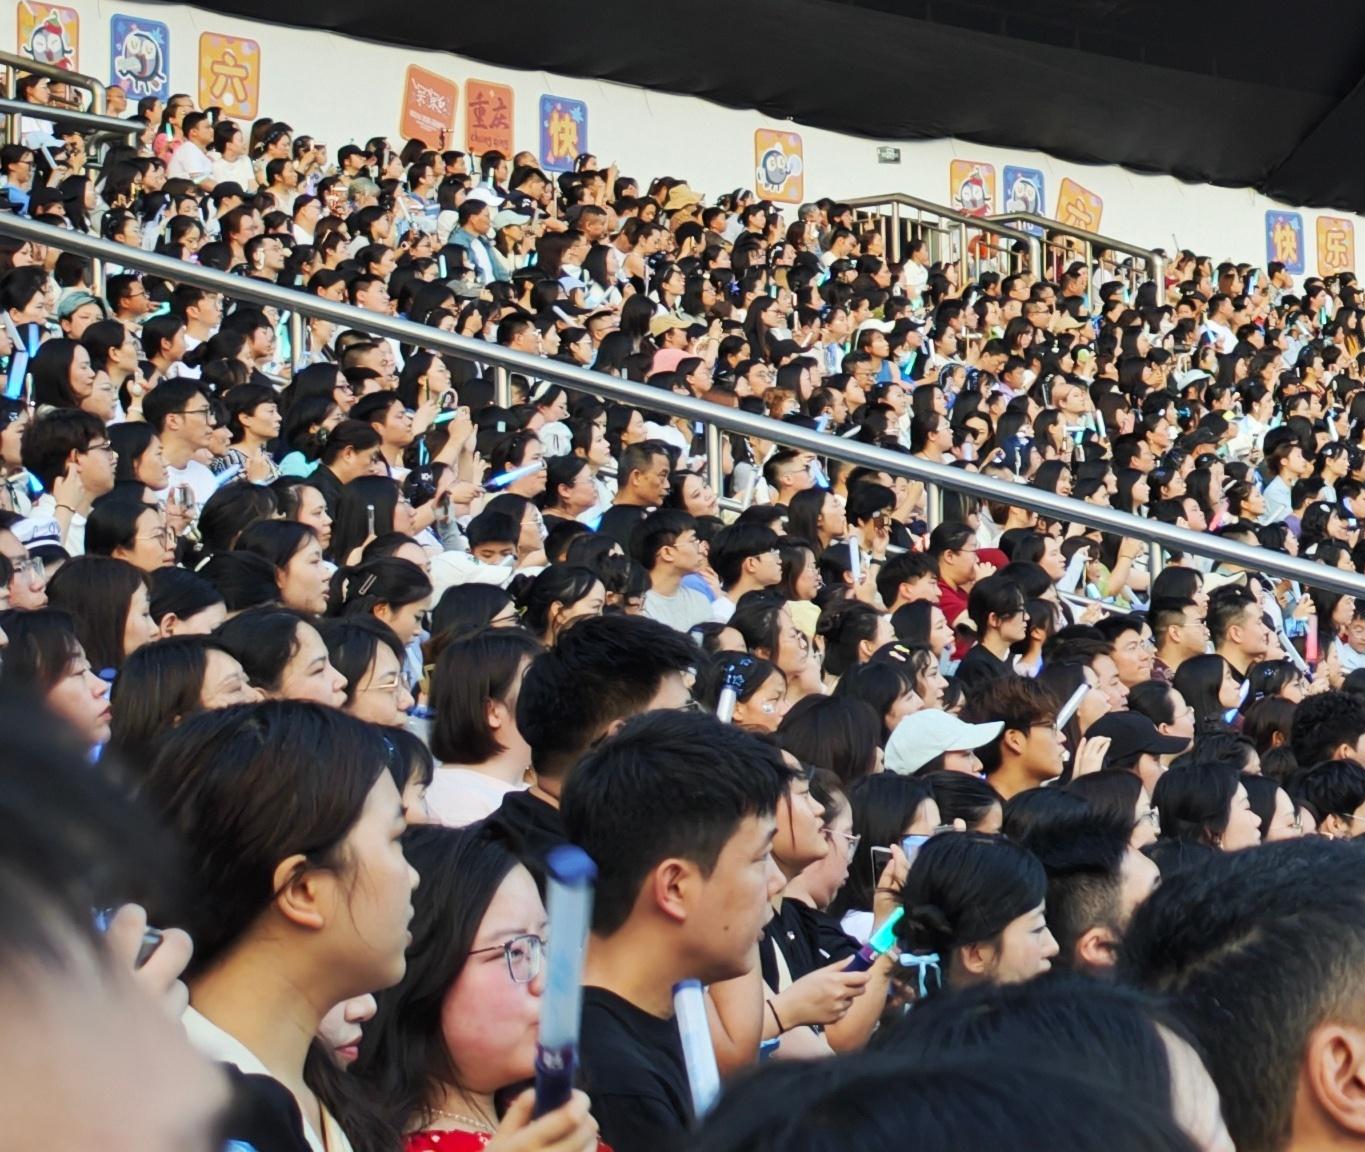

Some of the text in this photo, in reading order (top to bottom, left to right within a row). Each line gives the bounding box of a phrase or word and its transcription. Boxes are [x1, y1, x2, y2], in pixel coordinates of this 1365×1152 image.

[211, 50, 249, 103] 六
[468, 91, 510, 129] 重庆
[549, 109, 579, 160] 快
[1273, 222, 1298, 263] 快
[1325, 229, 1349, 268] 乐
